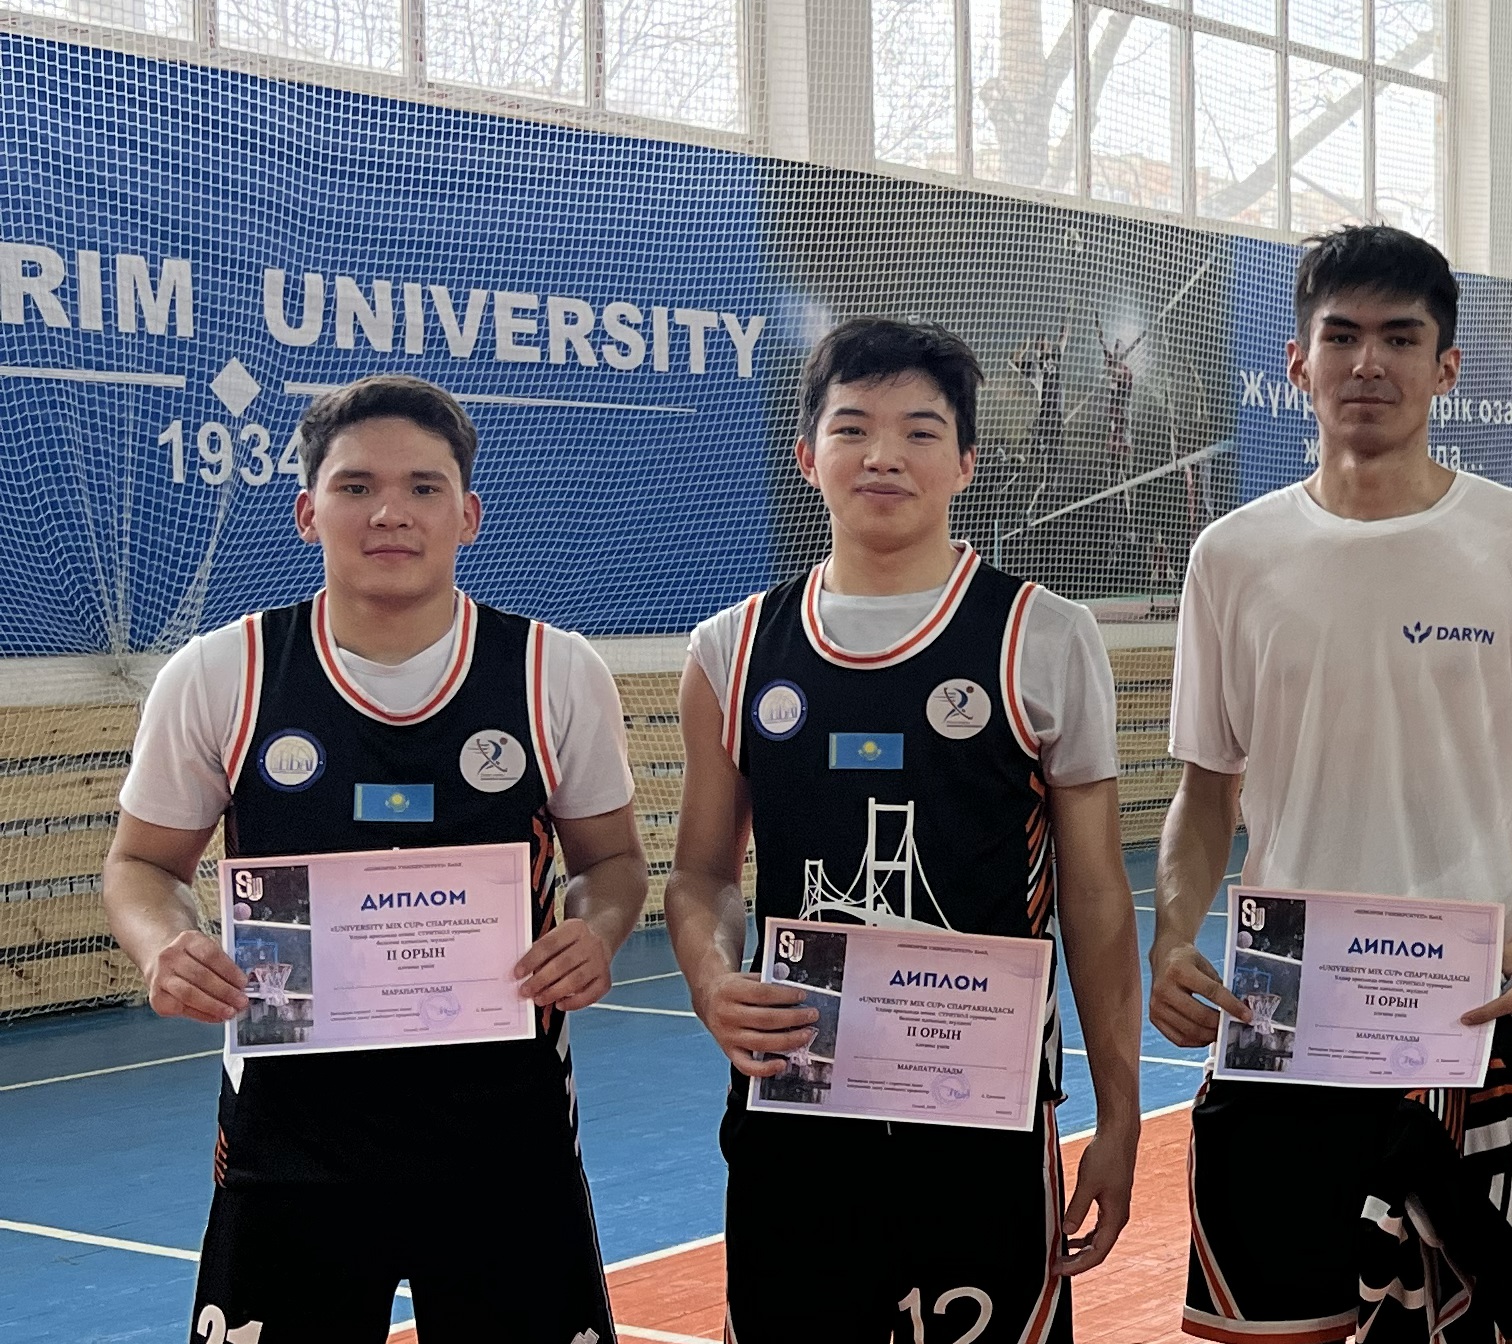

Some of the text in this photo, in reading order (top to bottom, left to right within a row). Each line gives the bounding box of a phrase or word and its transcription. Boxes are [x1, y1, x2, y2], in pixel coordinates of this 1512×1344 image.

[0, 241, 767, 379] RIM UNIVERSITY
[157, 418, 306, 487] 1934
[1436, 626, 1495, 645] DARYN
[360, 889, 467, 912] ДИПЛОМ
[400, 946, 446, 960] ОРЫН
[1347, 937, 1444, 960] ДИПЛОМ
[889, 969, 988, 993] ДИПЛОМ
[1378, 995, 1419, 1009] ОРЫН
[919, 1026, 962, 1041] ОРЫН
